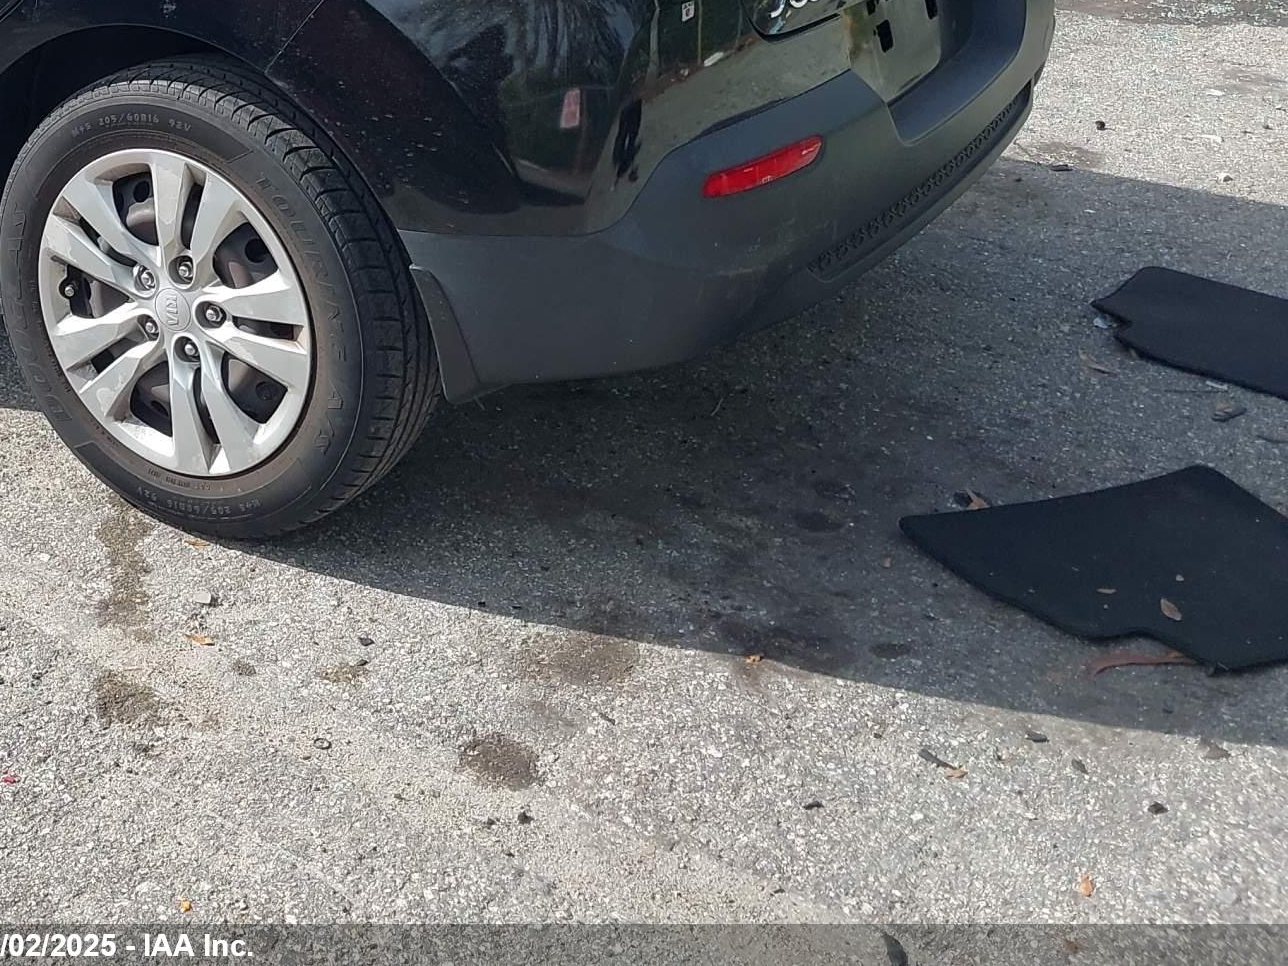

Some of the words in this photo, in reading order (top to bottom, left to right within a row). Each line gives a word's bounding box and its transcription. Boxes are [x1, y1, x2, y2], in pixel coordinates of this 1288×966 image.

[97, 113, 160, 127] 205/60R16
[167, 118, 192, 132] 92V
[166, 295, 180, 327] KIA
